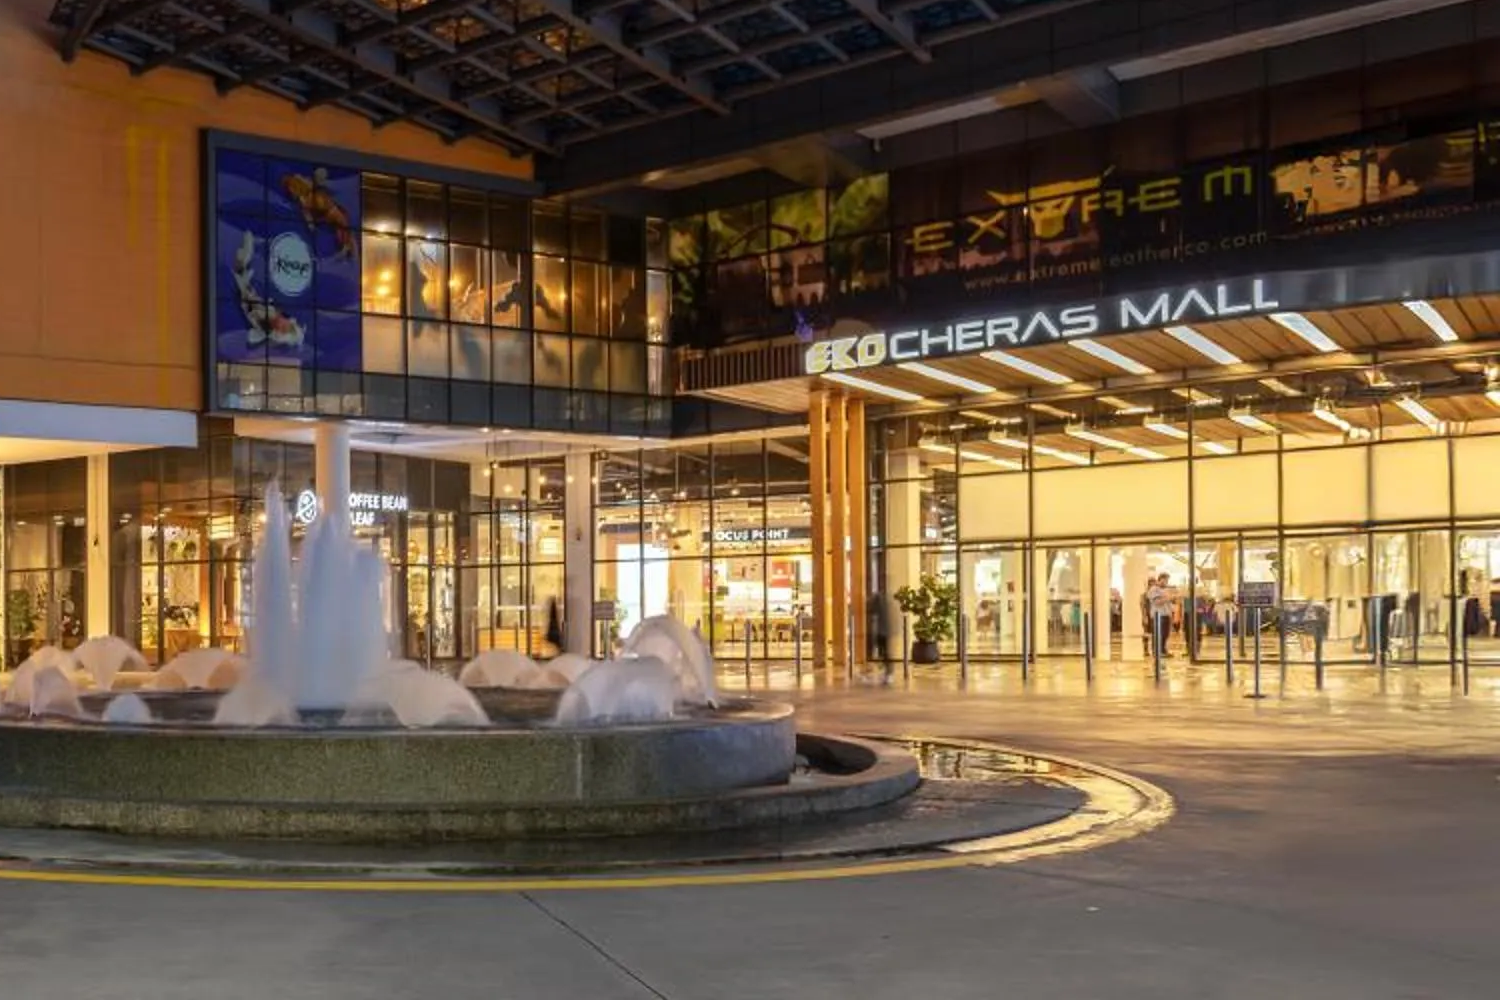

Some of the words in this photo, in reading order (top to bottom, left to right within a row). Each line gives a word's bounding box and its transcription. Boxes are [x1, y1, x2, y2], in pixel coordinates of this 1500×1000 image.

[1120, 279, 1279, 329] MALL
[348, 492, 380, 509] OFFEE
[381, 495, 407, 511] BEAN
[715, 530, 749, 541] OCUS
